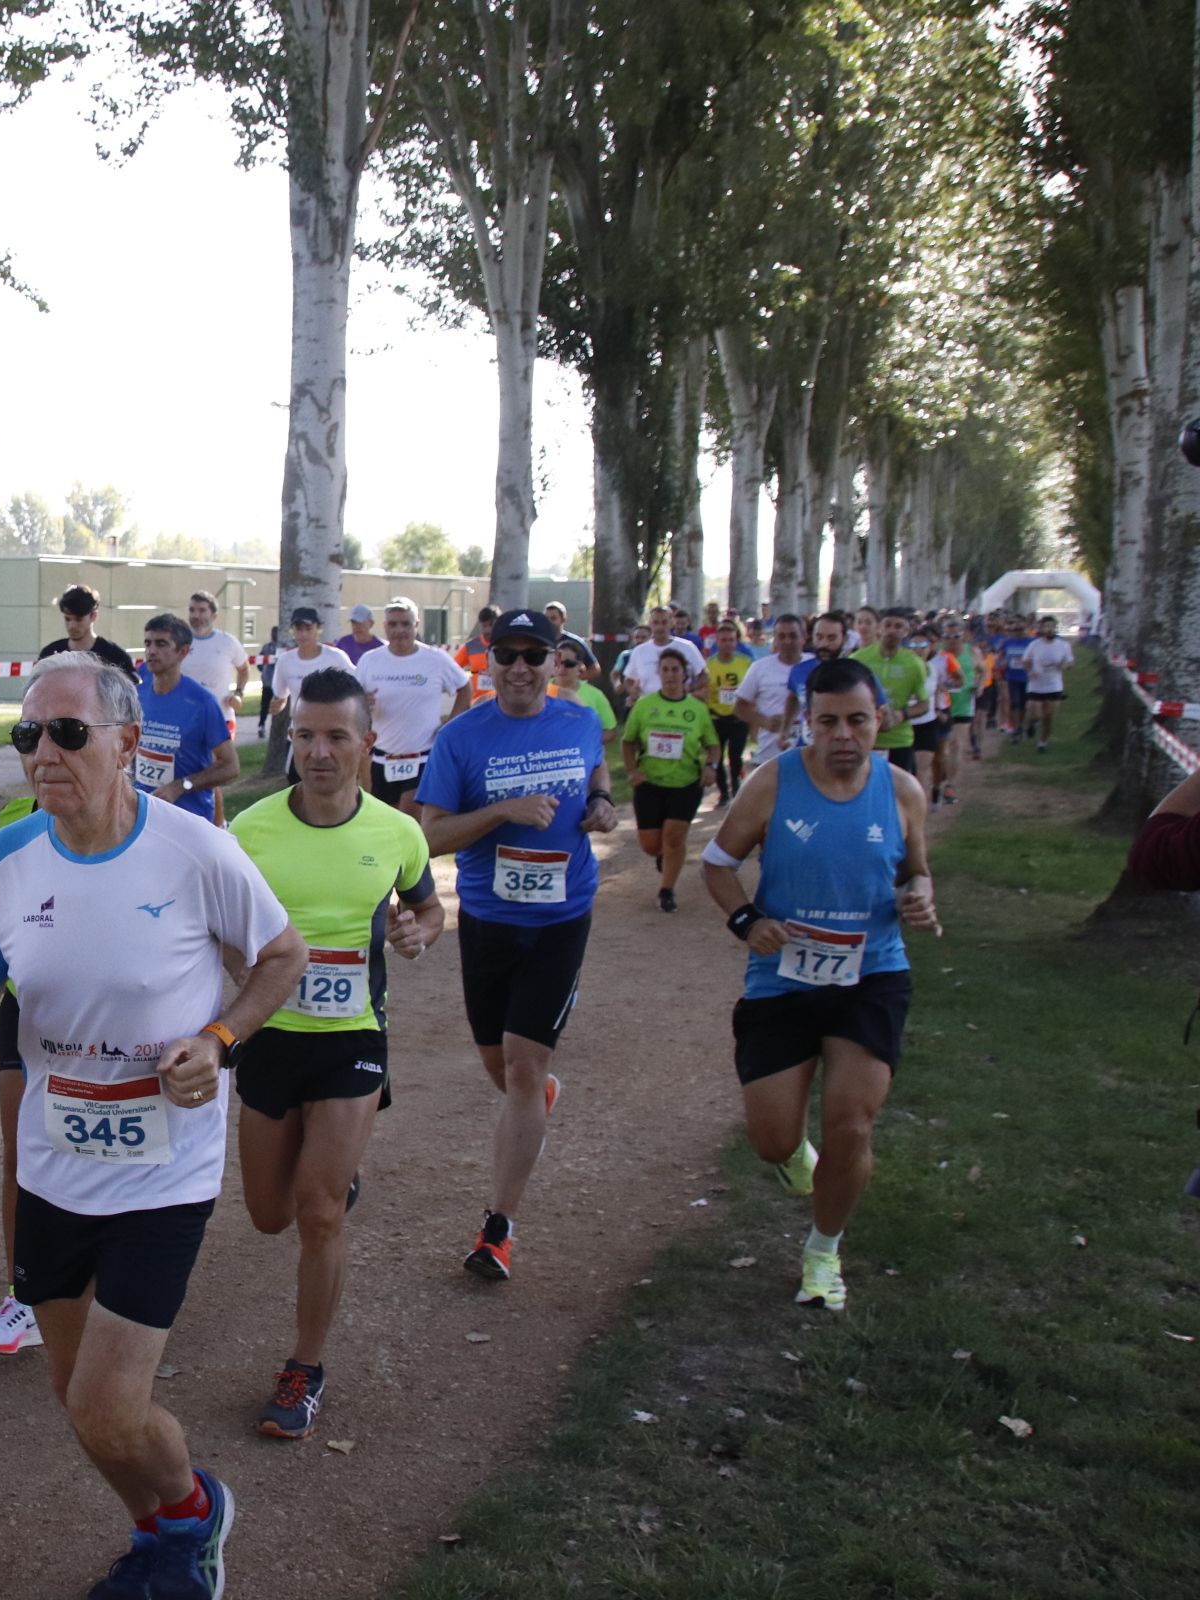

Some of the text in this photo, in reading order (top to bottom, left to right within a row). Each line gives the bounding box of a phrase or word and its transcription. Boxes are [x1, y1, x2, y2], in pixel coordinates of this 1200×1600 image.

[488, 747, 580, 767] Carrera Salamanca
[138, 763, 166, 781] 227
[391, 764, 414, 775] 140
[485, 765, 521, 779] Ciudad
[523, 756, 586, 773] Universitaria
[504, 870, 554, 891] 352
[23, 914, 54, 923] LABORAL
[796, 948, 848, 975] 177
[299, 976, 352, 1003] 129
[53, 1102, 157, 1116] Salamanca Ciudad Universitaria
[95, 1102, 120, 1110] Carrera
[63, 1114, 145, 1147] 345
